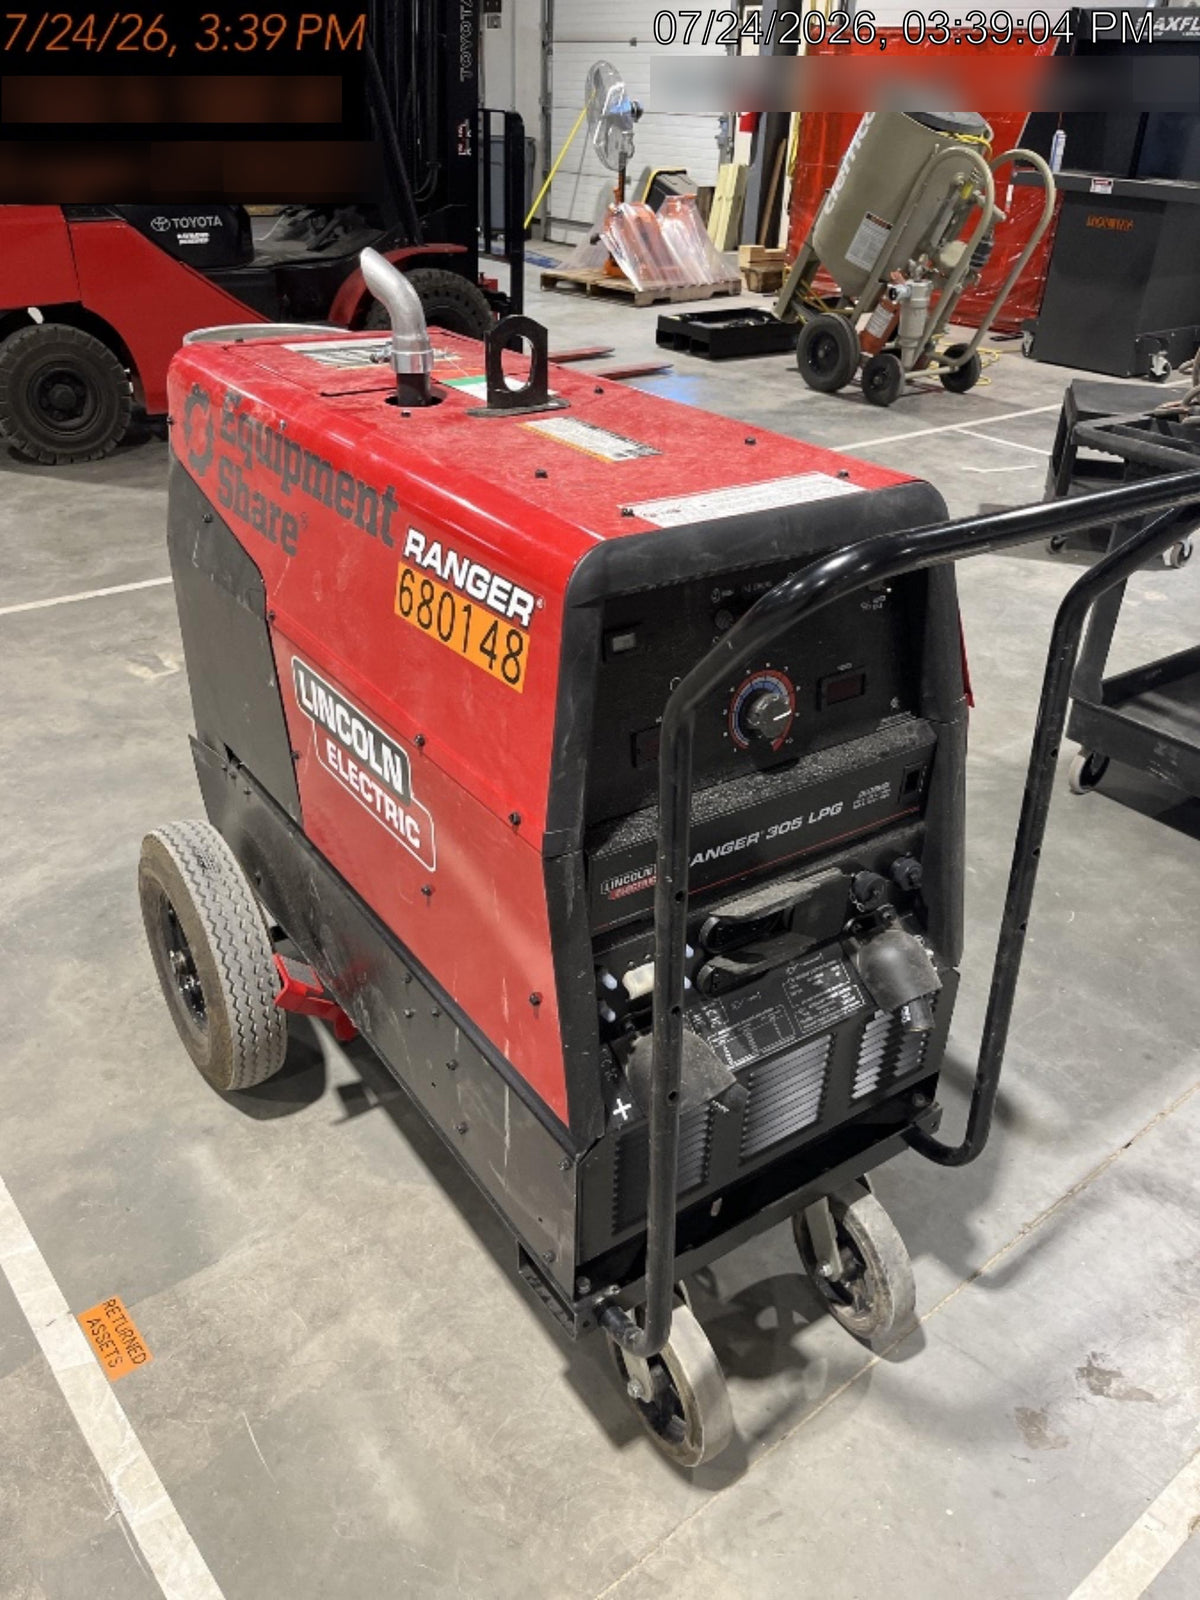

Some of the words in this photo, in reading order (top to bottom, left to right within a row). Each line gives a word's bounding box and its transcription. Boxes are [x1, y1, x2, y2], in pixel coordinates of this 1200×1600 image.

[171, 214, 223, 229] TOYOTA
[217, 456, 298, 557] Share
[218, 389, 400, 548] Equipment
[398, 567, 526, 687] 680148
[297, 672, 404, 794] LINCOLN
[326, 739, 421, 849] ELECTRIC
[689, 830, 761, 868] ANGER
[765, 815, 804, 840] 305
[807, 801, 844, 824] LPG
[86, 1317, 124, 1369] ASSETS
[102, 1297, 147, 1366] RETURNED
